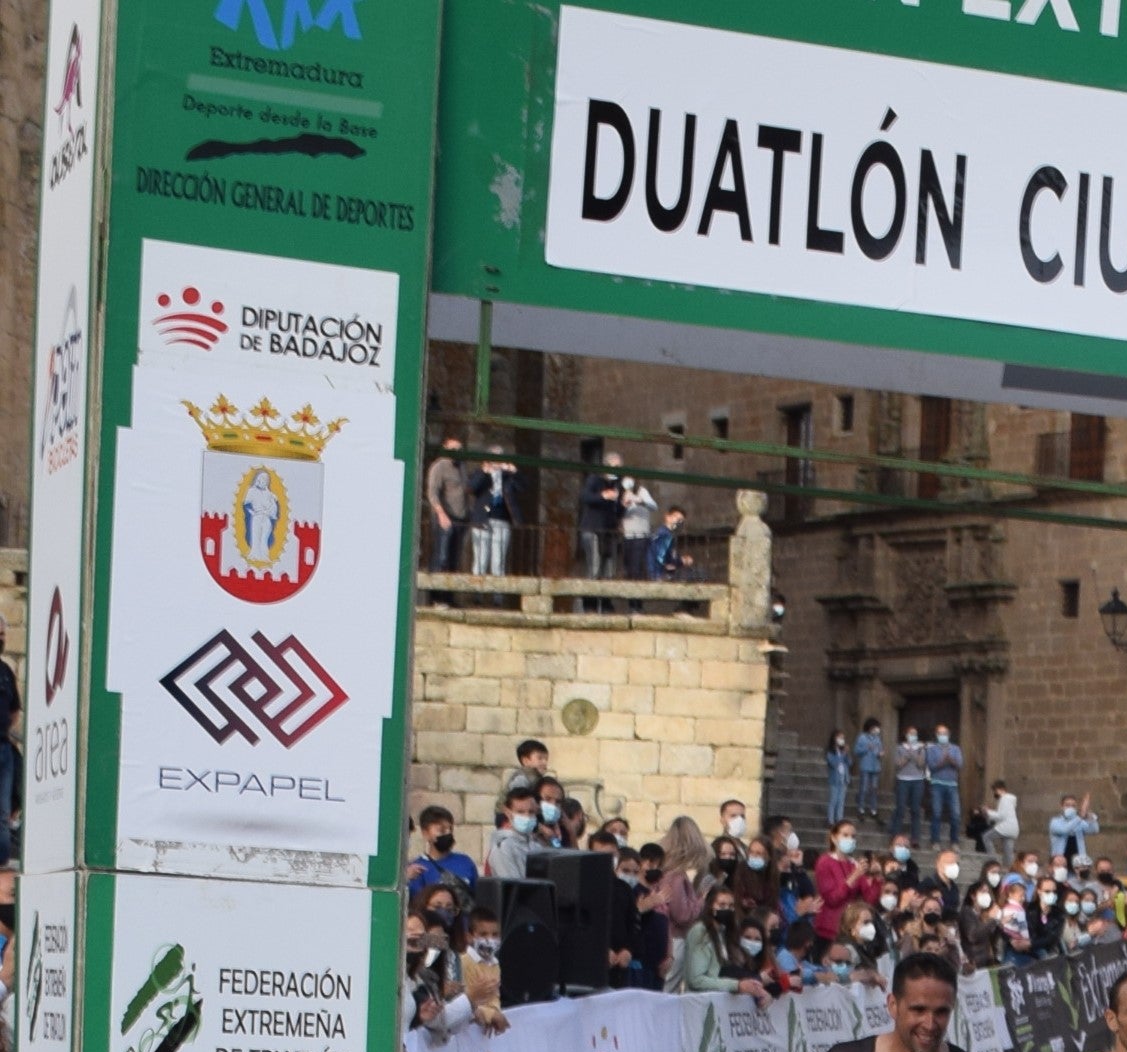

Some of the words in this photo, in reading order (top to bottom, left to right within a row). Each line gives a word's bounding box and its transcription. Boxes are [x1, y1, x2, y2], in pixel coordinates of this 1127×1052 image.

[209, 46, 364, 88] Extremadura
[183, 93, 253, 119] Deporte
[259, 106, 310, 129] desde
[316, 115, 333, 132] la
[340, 118, 378, 139] Base
[135, 166, 226, 206] DIRECCIÓN
[231, 181, 306, 217] GENERAL
[311, 191, 331, 220] DE
[336, 196, 415, 231] DEPORTES
[581, 98, 968, 271] DUATLÓN
[241, 304, 383, 345] DIPUTACIÓN
[240, 335, 263, 353] DE
[269, 336, 382, 368] BADAJOZ
[159, 766, 346, 803] EXPAPEL
[219, 967, 352, 1000] FEDERACIÓN
[222, 1008, 347, 1040] EXTREMEÑA
